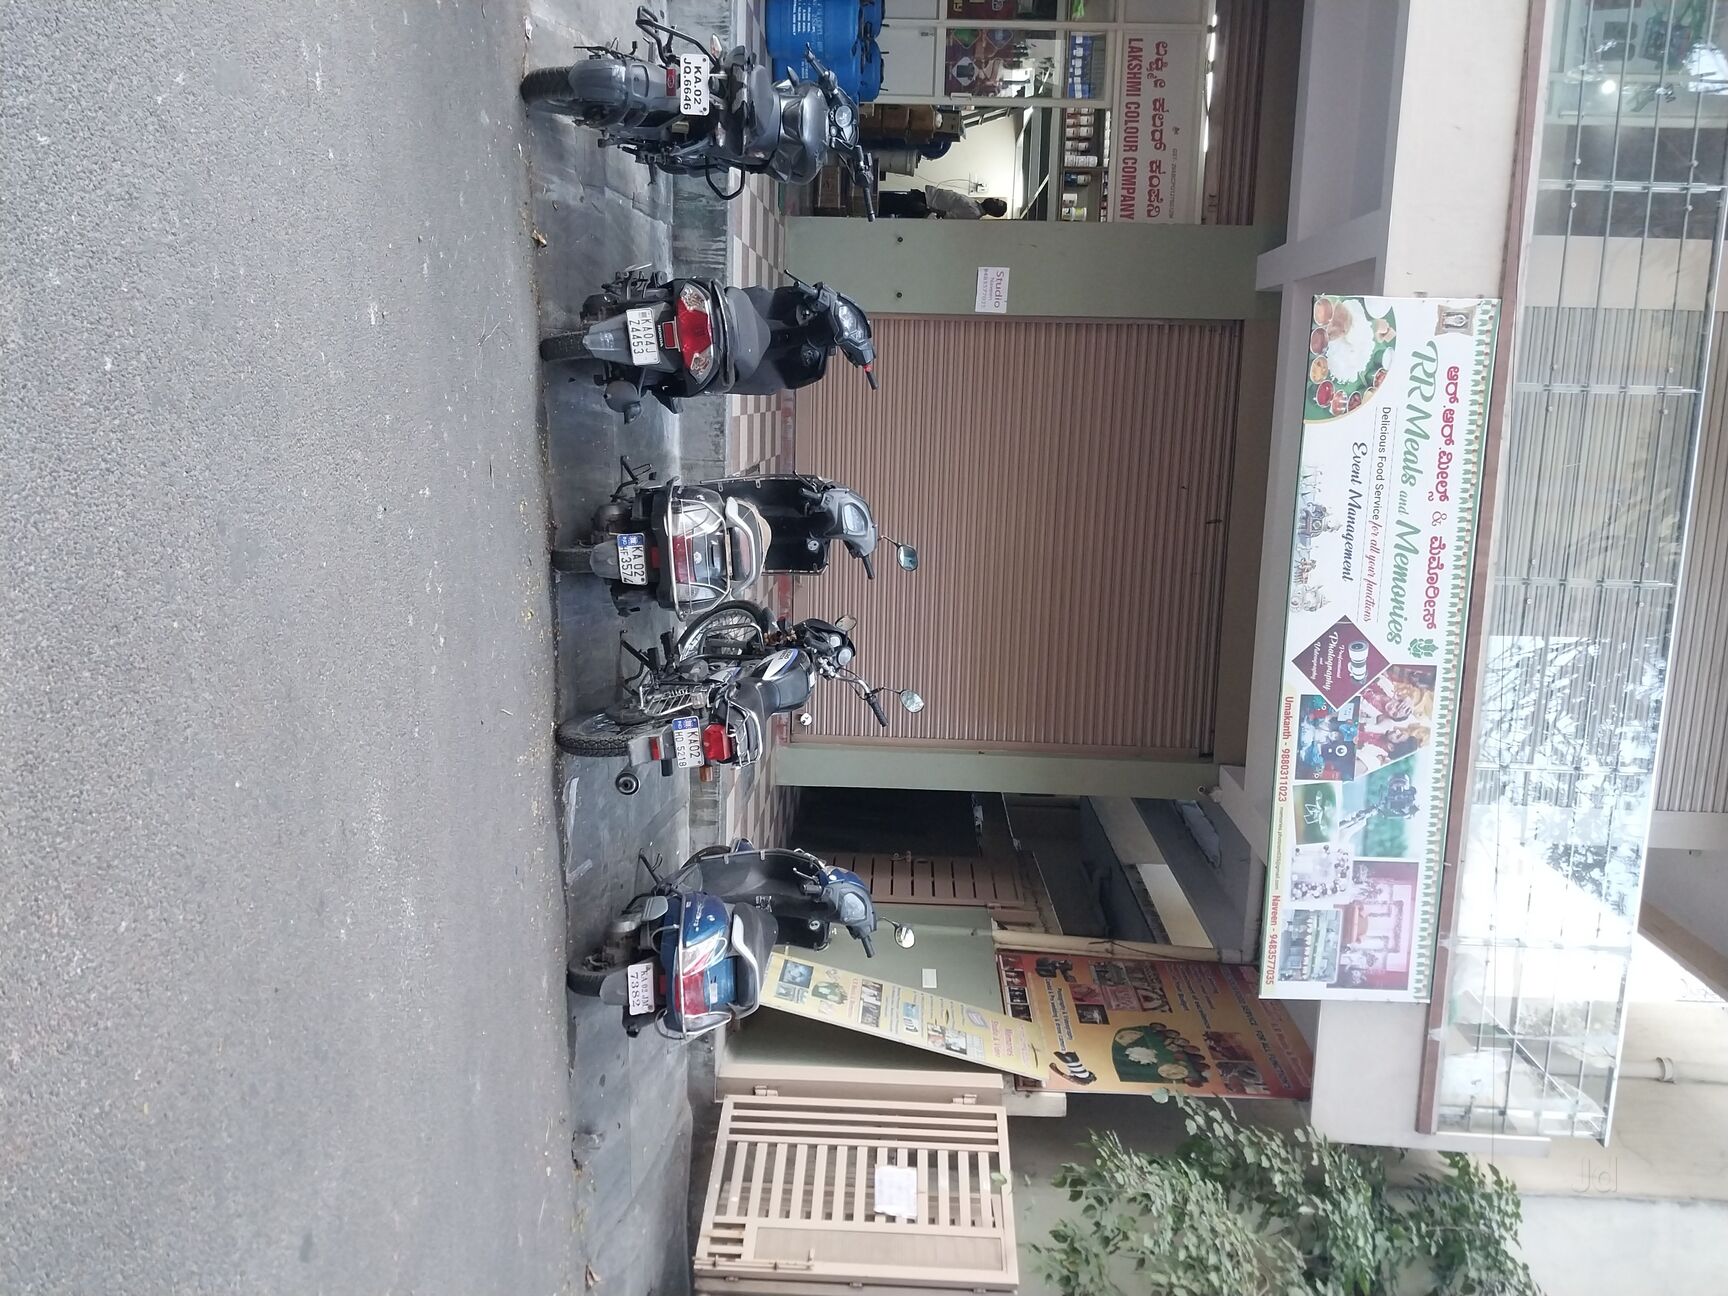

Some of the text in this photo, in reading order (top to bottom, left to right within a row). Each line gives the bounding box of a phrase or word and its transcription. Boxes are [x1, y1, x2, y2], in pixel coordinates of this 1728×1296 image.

[683, 58, 692, 110] JQ.6646
[694, 66, 702, 104] KA.02
[1120, 38, 1143, 220] LAKSHMI COLOUR COMPANY
[1150, 97, 1169, 151] ಕಲರ್
[994, 272, 1004, 308] Studio
[1342, 442, 1368, 582] Event Management
[1364, 407, 1391, 622] Delicious Food Service for all your functions
[1386, 341, 1438, 645] RR Meals and Memories
[1432, 511, 1447, 526] &
[632, 546, 644, 577] KA 02
[1322, 632, 1338, 690] Photography
[1282, 696, 1294, 740] Umakanth
[688, 731, 700, 758] KA02
[1278, 748, 1290, 802] 9880311023
[1270, 896, 1280, 925] Naveen
[1266, 934, 1278, 984] 9483577035
[630, 972, 640, 1008] 7382
[642, 984, 648, 992] 02
